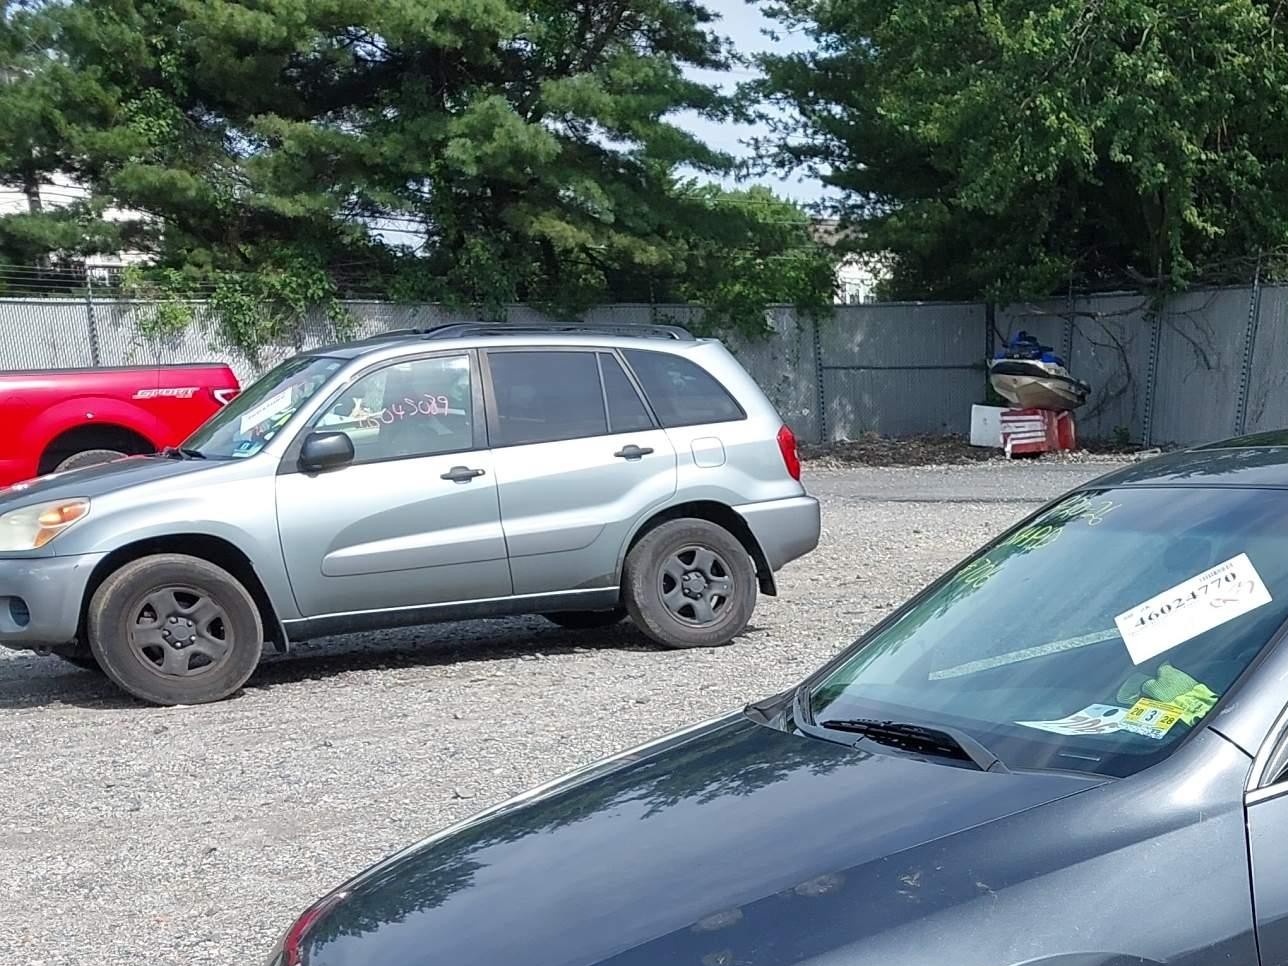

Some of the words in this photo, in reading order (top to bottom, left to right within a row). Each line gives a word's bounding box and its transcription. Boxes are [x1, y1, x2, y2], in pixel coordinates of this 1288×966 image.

[1134, 572, 1237, 628] 46024770
[1145, 710, 1158, 722] 3
[1160, 716, 1175, 725] 28
